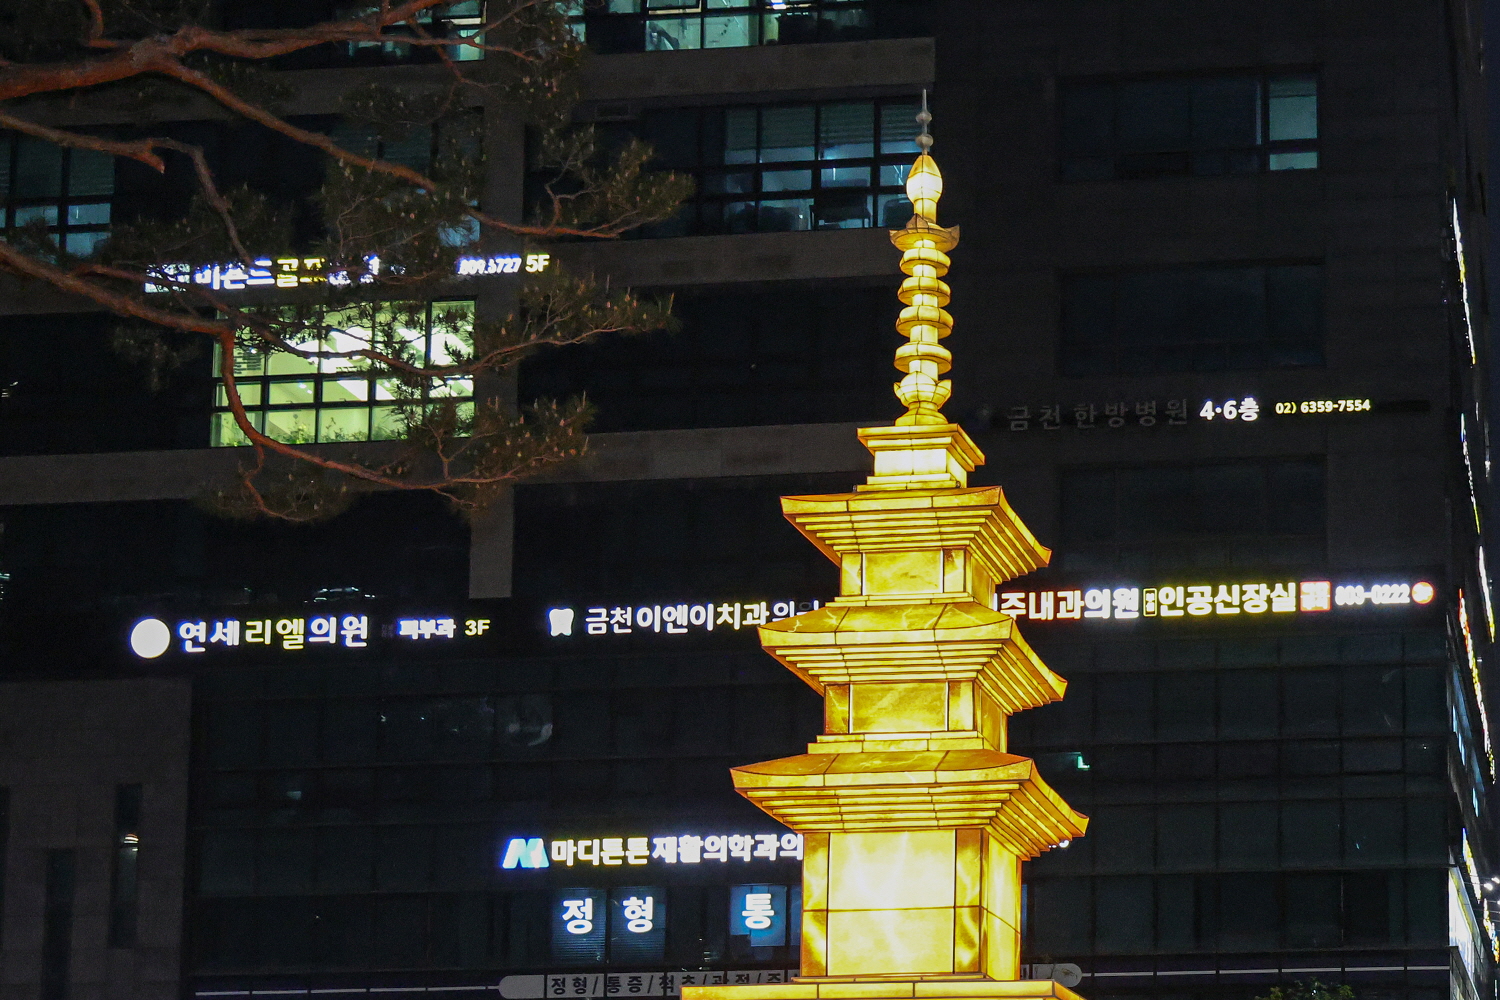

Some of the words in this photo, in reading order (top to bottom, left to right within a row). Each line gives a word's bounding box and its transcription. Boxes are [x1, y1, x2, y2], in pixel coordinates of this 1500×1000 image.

[525, 254, 550, 273] 5F
[1300, 399, 1371, 414] 6359-7554
[993, 587, 1140, 620] 주내과의원
[1158, 581, 1297, 617] 인공신장실
[179, 616, 368, 653] 연세리엘의원
[464, 619, 491, 637] 3F
